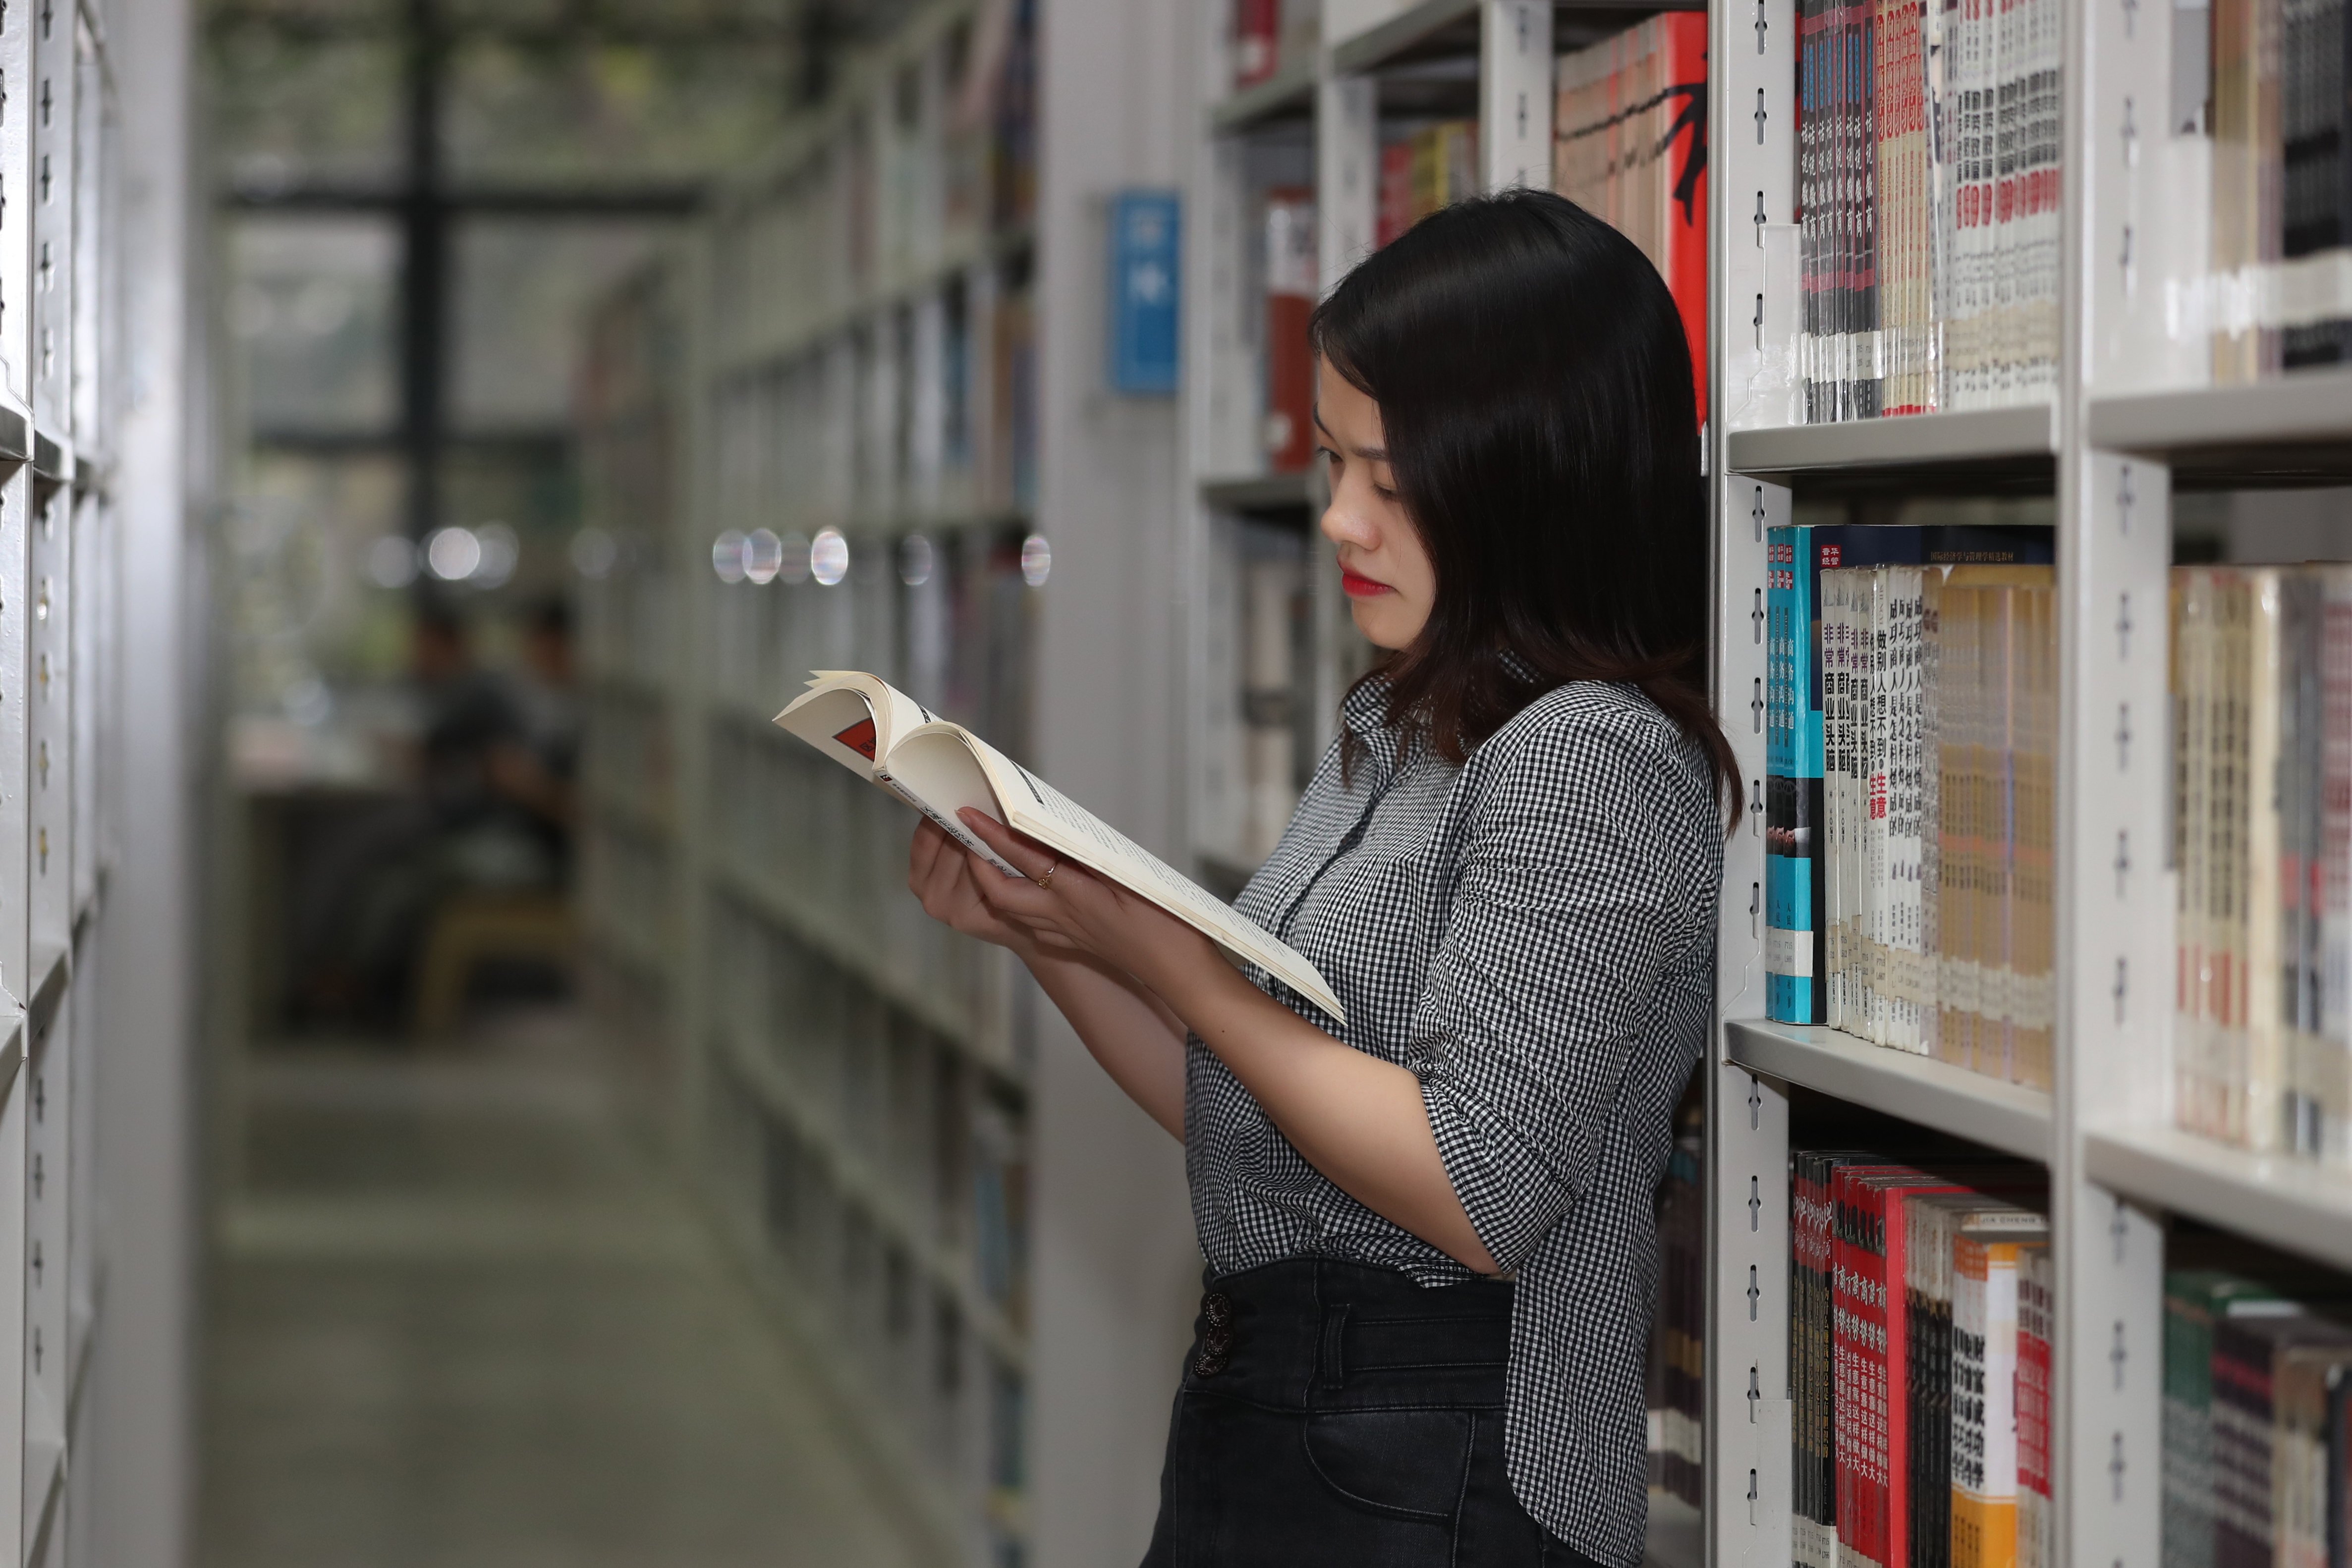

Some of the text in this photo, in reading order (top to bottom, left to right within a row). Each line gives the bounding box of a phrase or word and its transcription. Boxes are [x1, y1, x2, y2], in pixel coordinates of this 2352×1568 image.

[1822, 547, 1840, 556] 普华
[1822, 556, 1840, 565] 经管
[1824, 623, 1835, 771] 非常商业头脑
